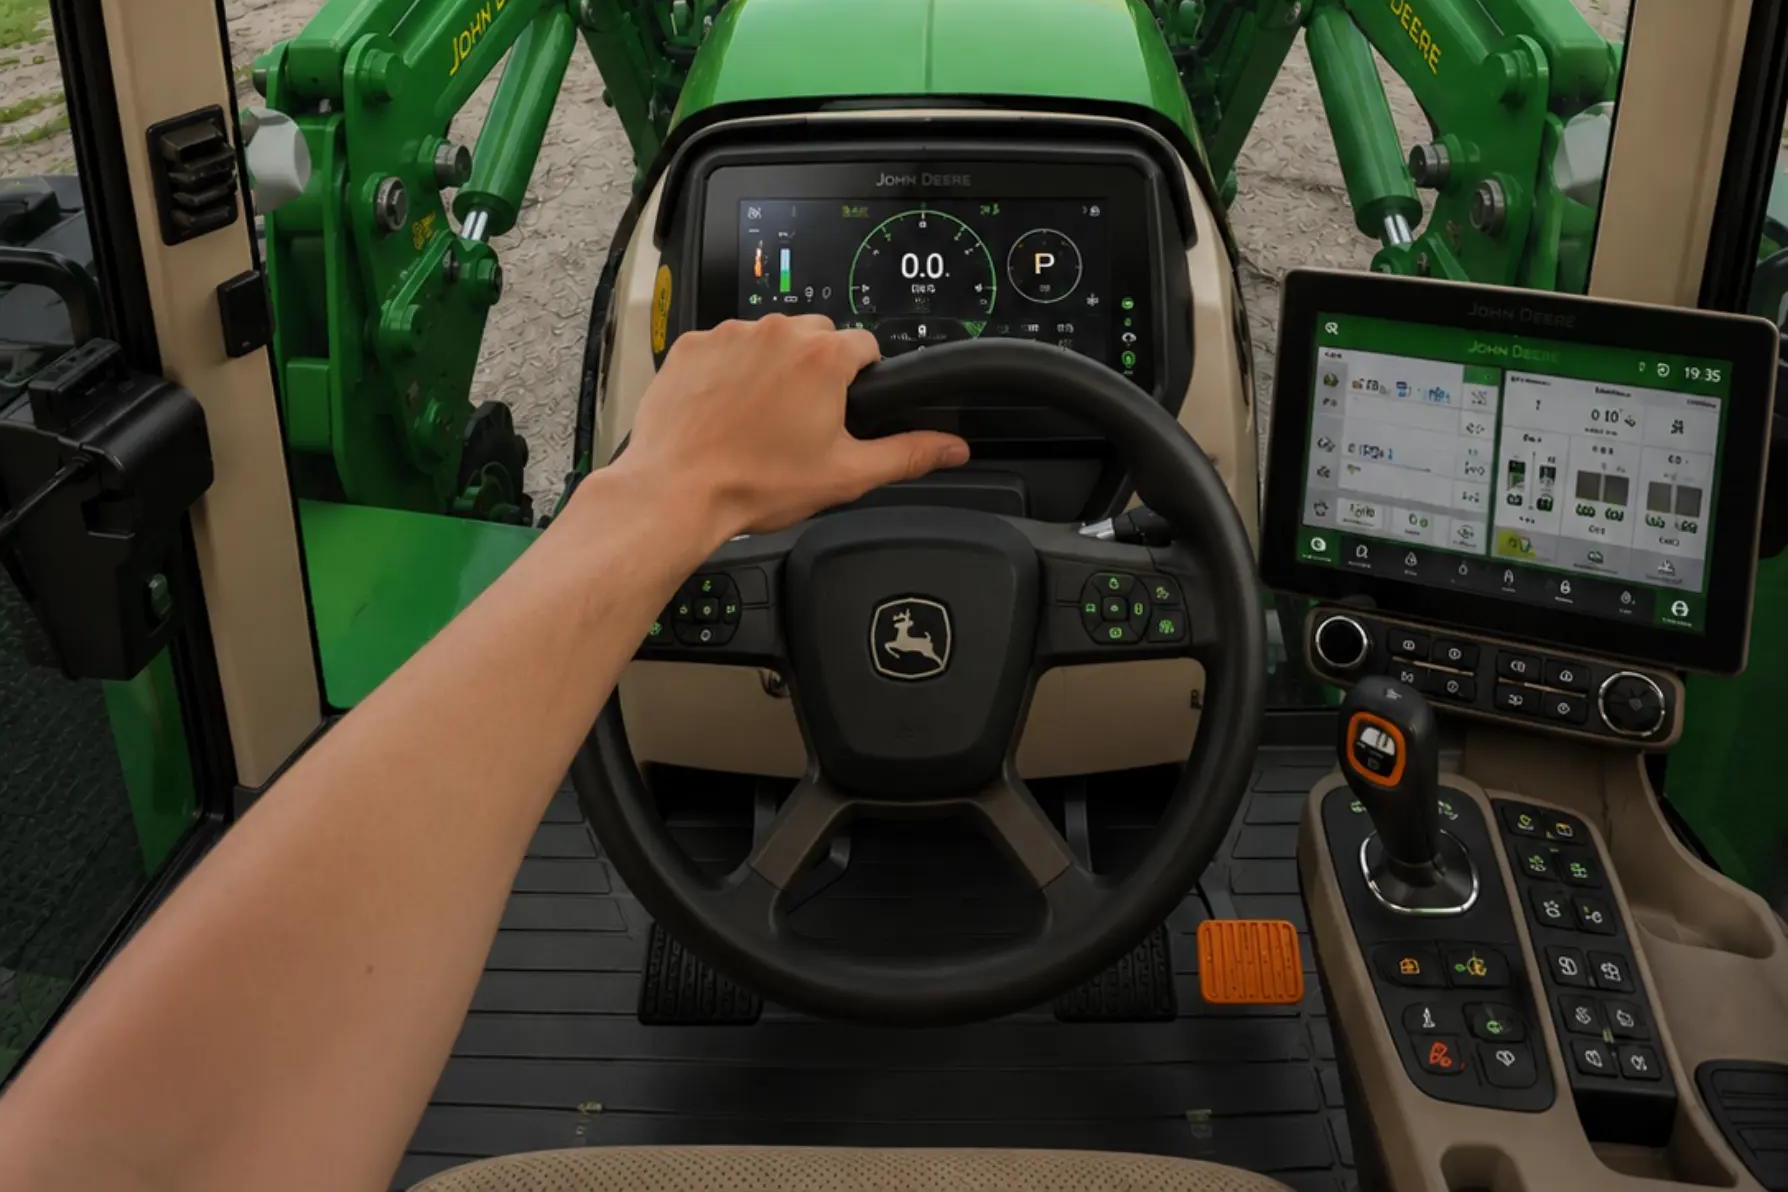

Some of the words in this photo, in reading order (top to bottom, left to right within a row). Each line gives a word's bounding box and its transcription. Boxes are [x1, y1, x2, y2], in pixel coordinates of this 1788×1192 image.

[449, 1, 491, 76] JOHN
[901, 252, 944, 279] 0.0
[1034, 252, 1056, 275] P
